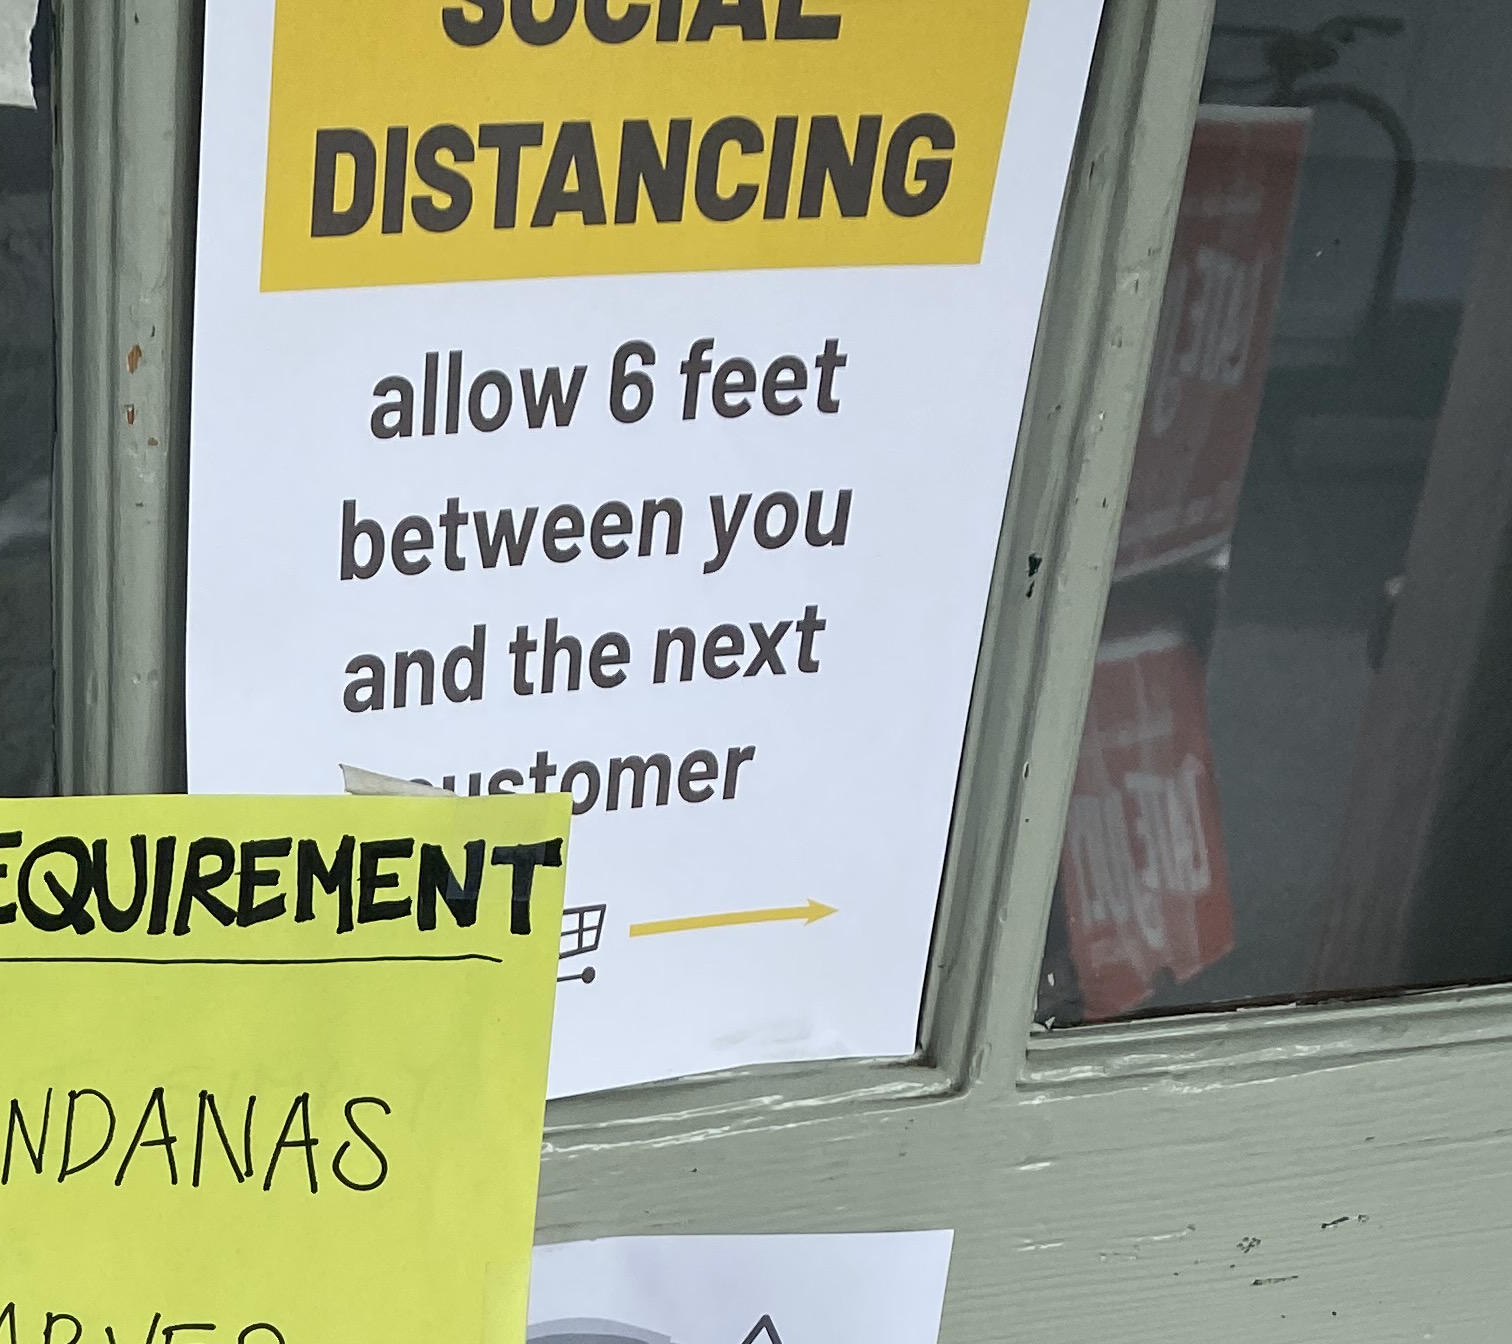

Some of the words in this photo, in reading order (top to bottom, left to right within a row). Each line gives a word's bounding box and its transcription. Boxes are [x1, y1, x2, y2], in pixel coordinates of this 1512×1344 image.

[311, 113, 955, 237] DISTANCING
[371, 350, 587, 439] allow
[610, 341, 655, 423] 6
[680, 338, 847, 420] feet
[341, 497, 682, 580] between
[703, 489, 852, 574] you
[344, 624, 486, 713] and
[509, 618, 630, 695] the
[653, 605, 826, 684] next
